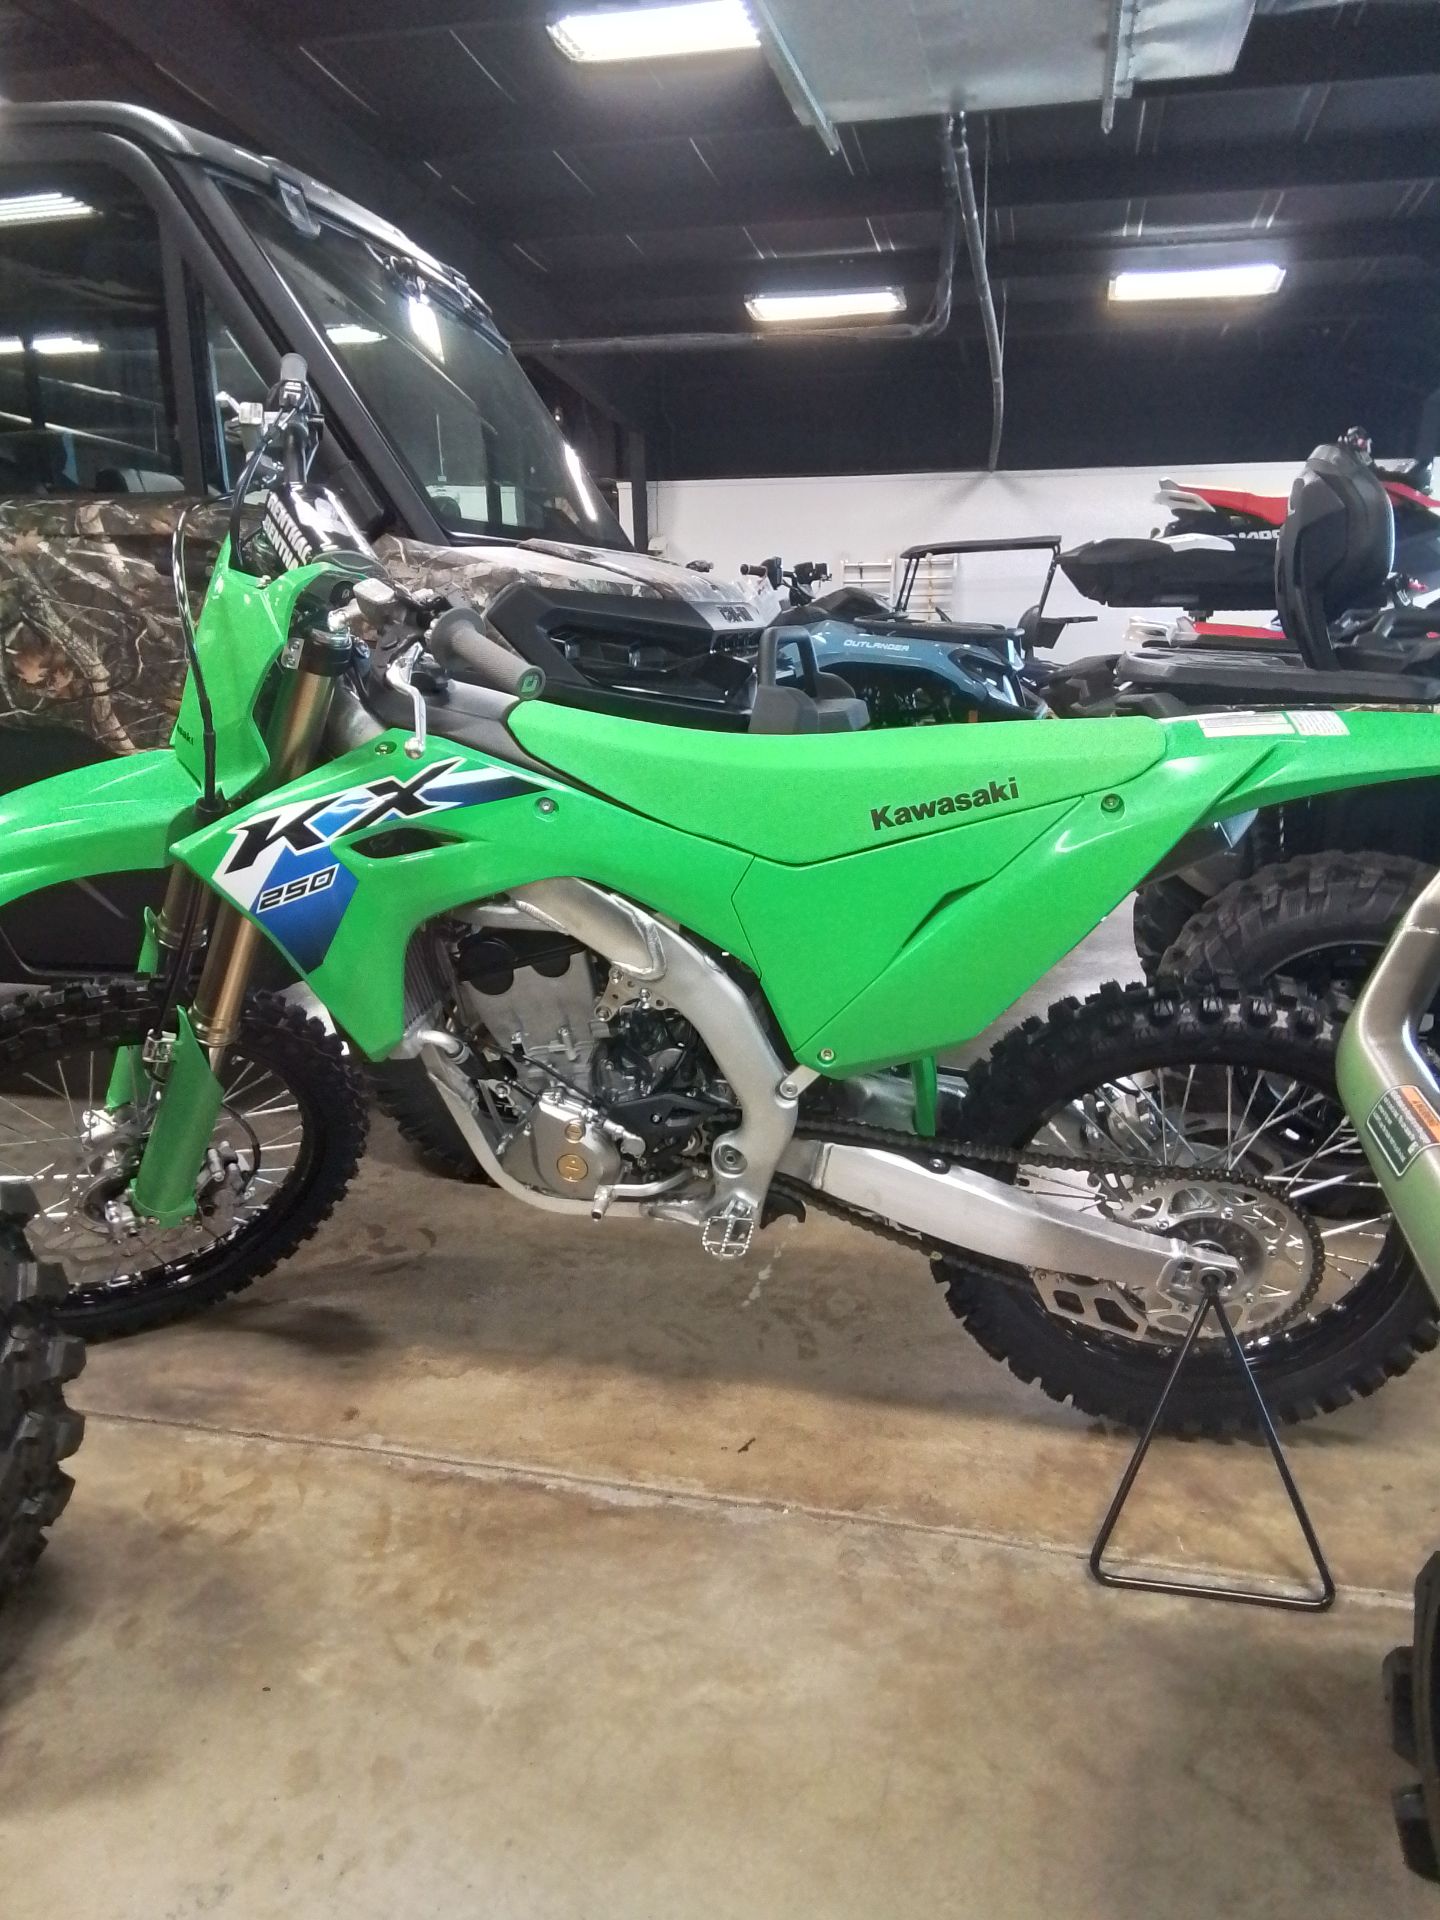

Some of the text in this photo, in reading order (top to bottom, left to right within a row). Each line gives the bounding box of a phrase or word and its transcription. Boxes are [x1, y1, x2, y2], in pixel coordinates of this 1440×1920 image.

[262, 513, 300, 571] RENTHA
[267, 491, 313, 566] RENTHAL
[843, 639, 910, 652] OUTLANDER
[225, 758, 464, 875] KX
[870, 776, 1020, 831] Kawasaki
[258, 865, 338, 911] 250
